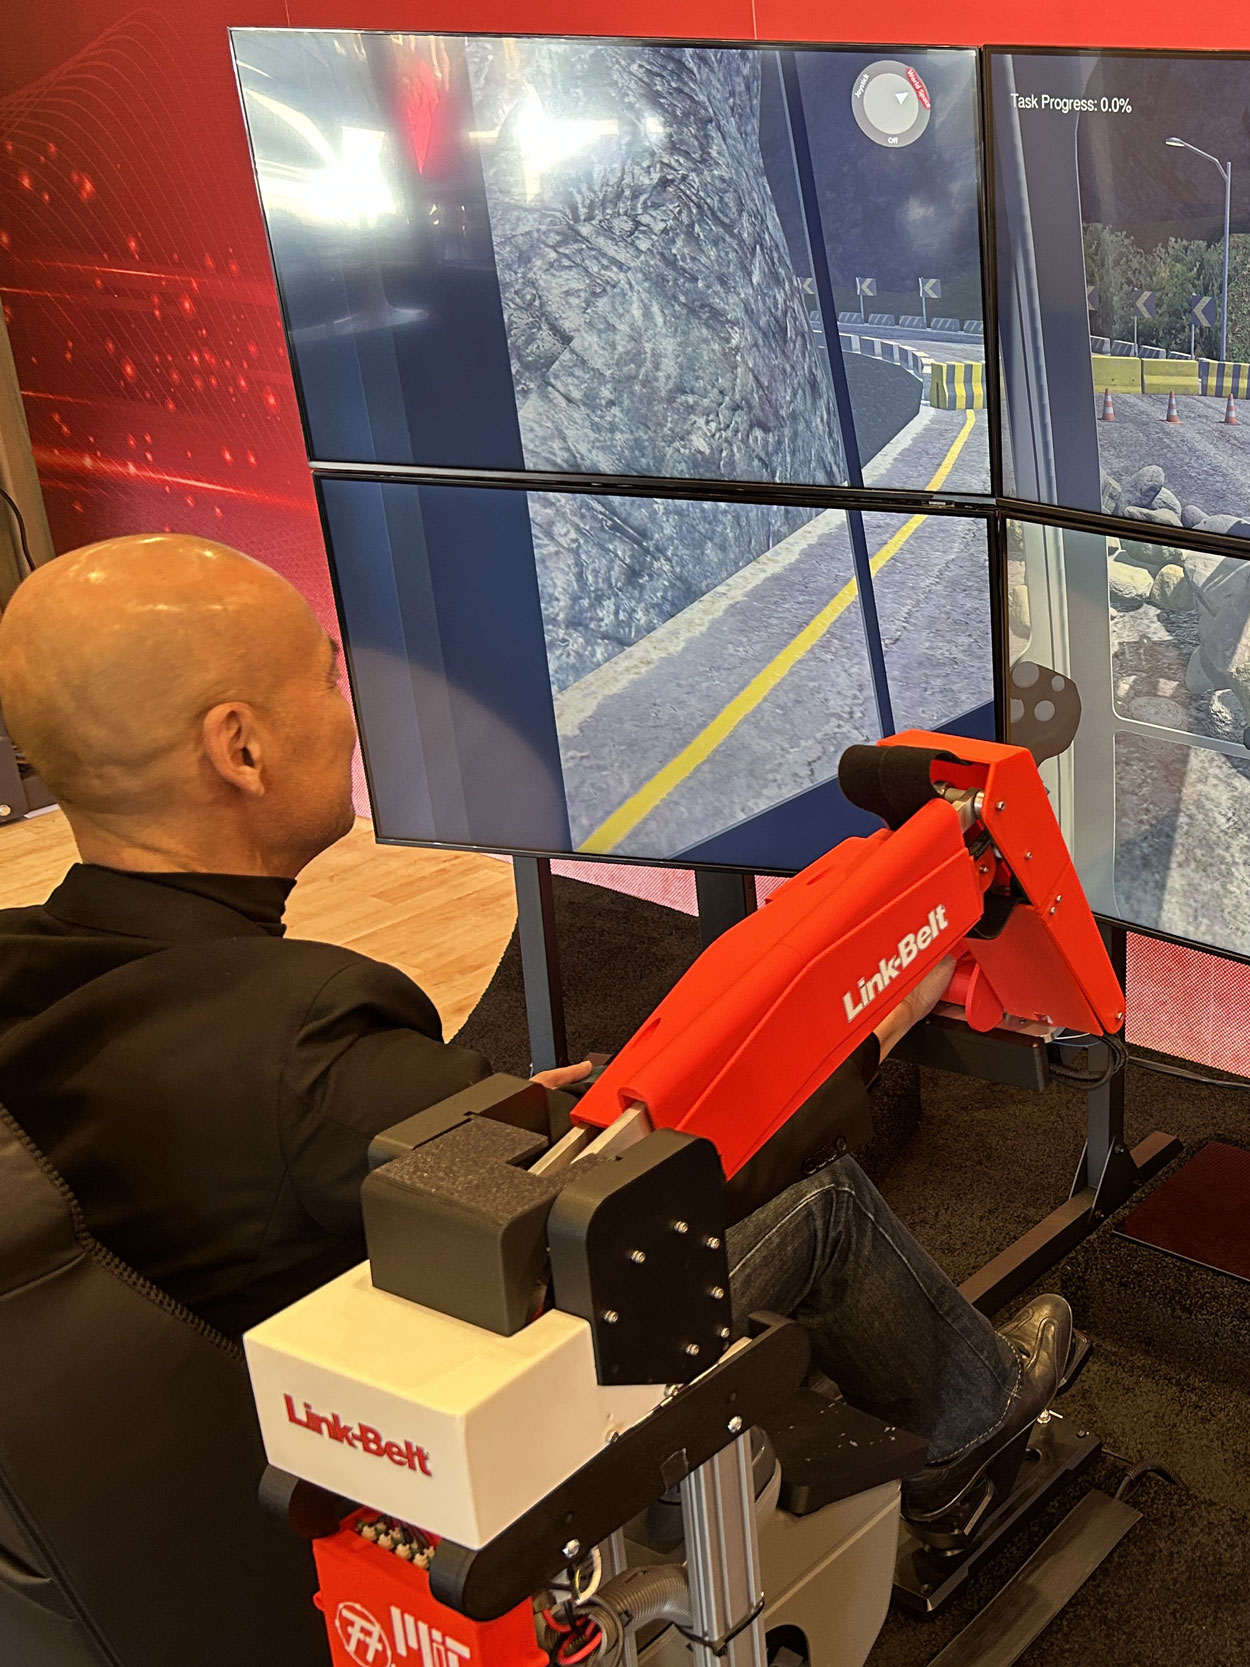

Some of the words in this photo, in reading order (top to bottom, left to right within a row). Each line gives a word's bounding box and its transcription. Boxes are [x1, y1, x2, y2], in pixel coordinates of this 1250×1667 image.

[854, 73, 870, 99] Joystick
[907, 69, 921, 90] World
[918, 88, 931, 109] Space
[1010, 93, 1038, 109] Task
[1041, 94, 1098, 114] Progress:
[1100, 97, 1132, 113] 0.0%
[887, 136, 899, 144] Off
[842, 904, 949, 1024] Link-Belt
[283, 1392, 433, 1478] Link-Belt
